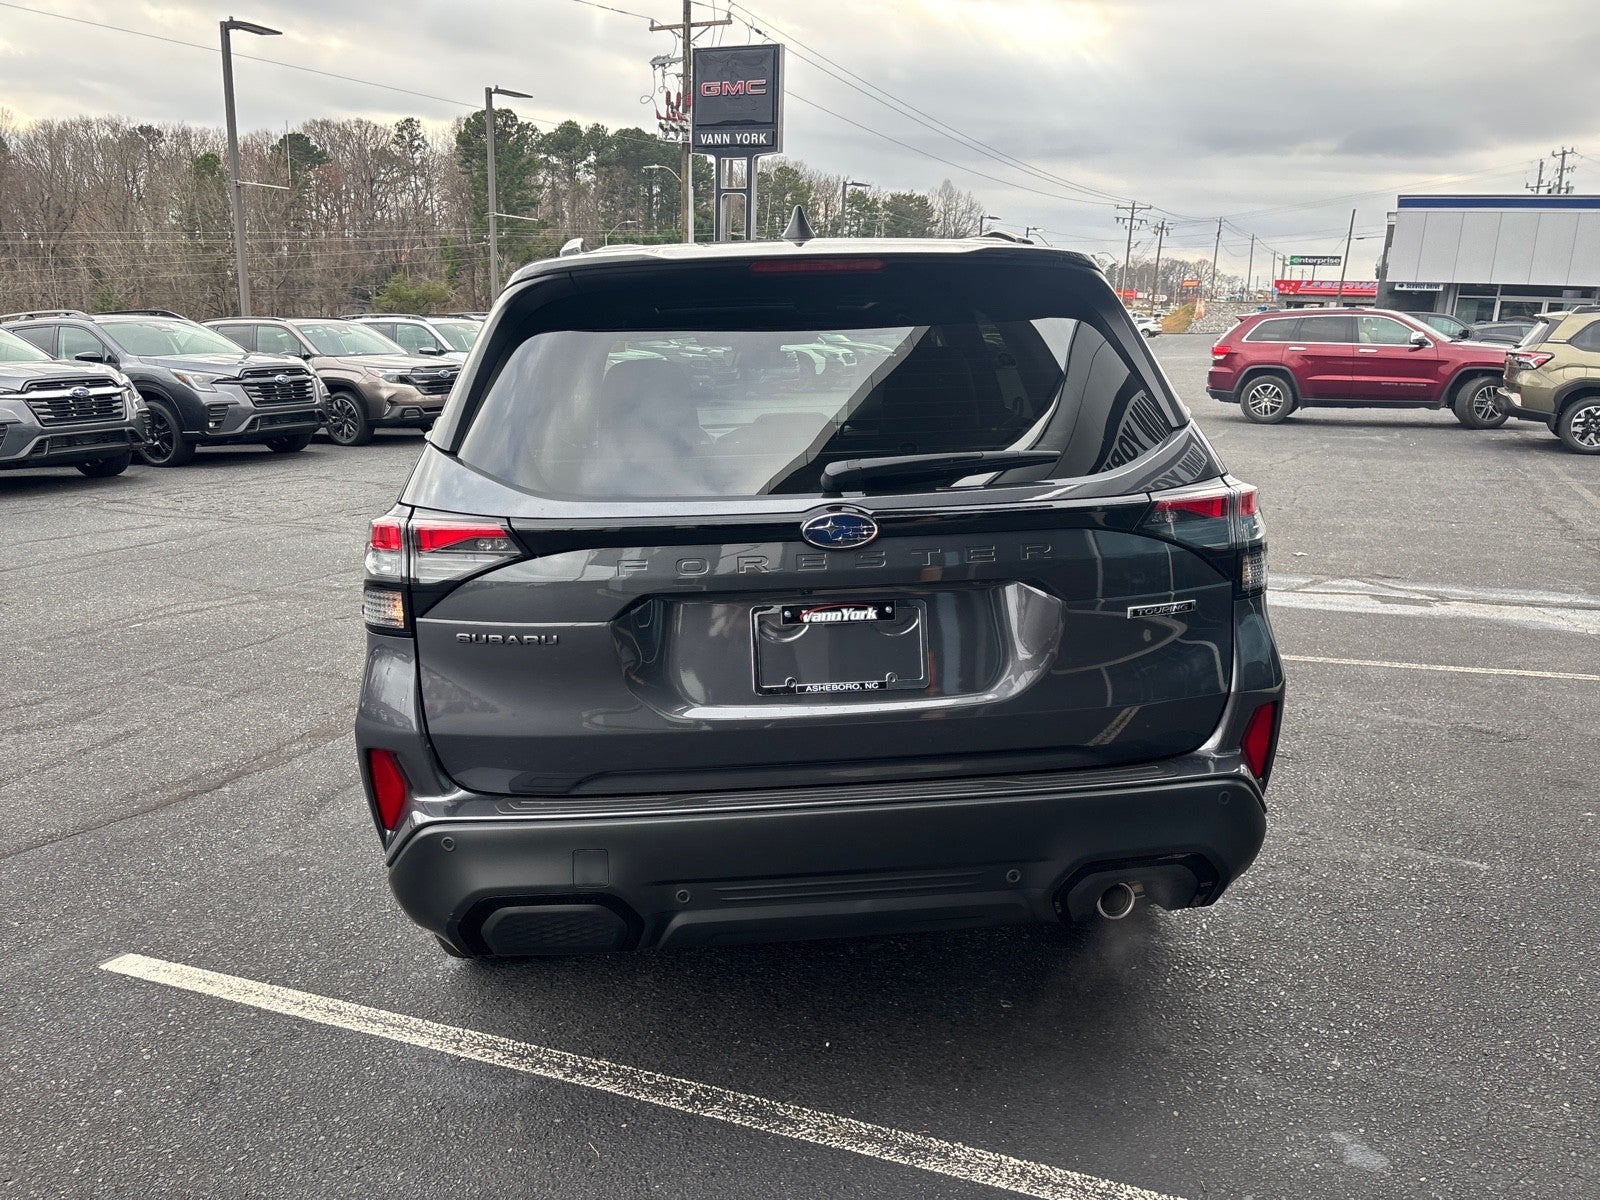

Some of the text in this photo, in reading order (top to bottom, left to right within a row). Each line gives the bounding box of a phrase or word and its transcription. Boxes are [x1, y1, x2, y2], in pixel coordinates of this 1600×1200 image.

[701, 79, 767, 97] GMC
[700, 133, 767, 145] VANN YORK
[1291, 257, 1341, 265] enterprise
[616, 543, 1053, 577] FORESTER
[1137, 603, 1189, 616] TOURING
[456, 633, 558, 645] SUBARU
[805, 684, 863, 692] ASHEBORO,
